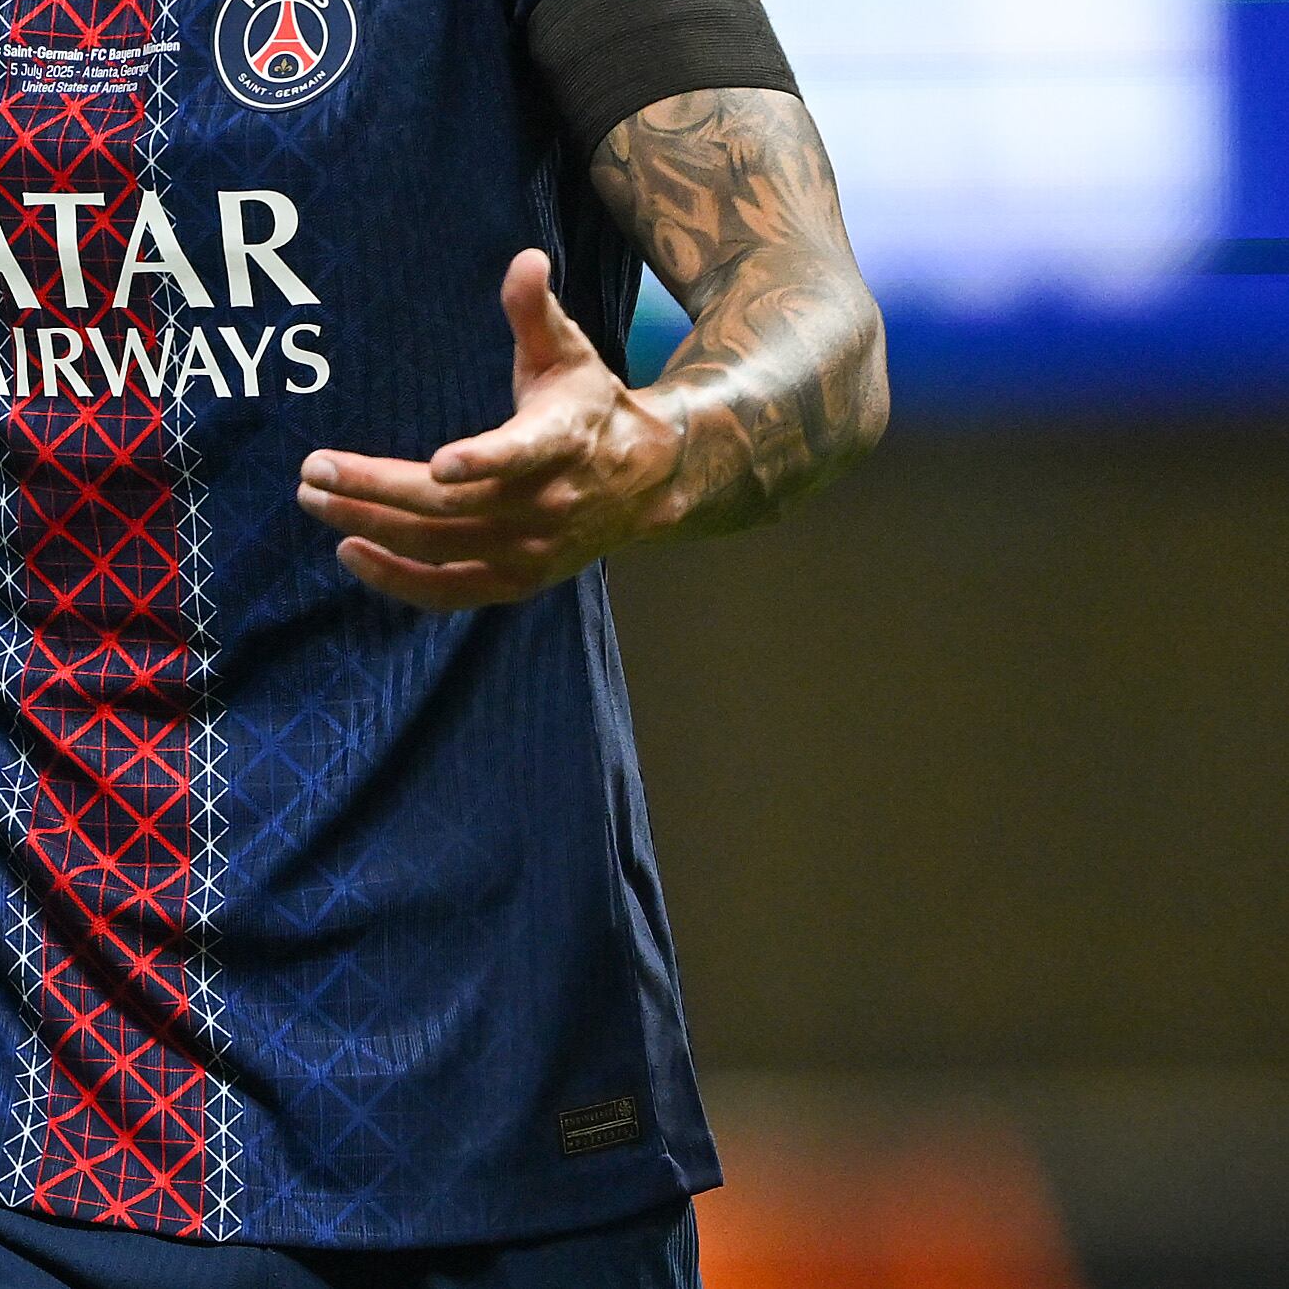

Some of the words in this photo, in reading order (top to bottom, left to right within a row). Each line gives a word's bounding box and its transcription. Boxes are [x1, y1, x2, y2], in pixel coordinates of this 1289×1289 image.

[3, 43, 83, 61] Saint-Germain
[90, 48, 106, 61] FC
[108, 47, 141, 63] Bayern
[10, 62, 18, 76] 5
[21, 63, 43, 79] July
[45, 65, 74, 78] 2025
[120, 61, 149, 77] Georgia
[21, 80, 56, 93] United
[55, 81, 87, 94] States
[89, 82, 101, 93] of
[101, 80, 138, 93] America
